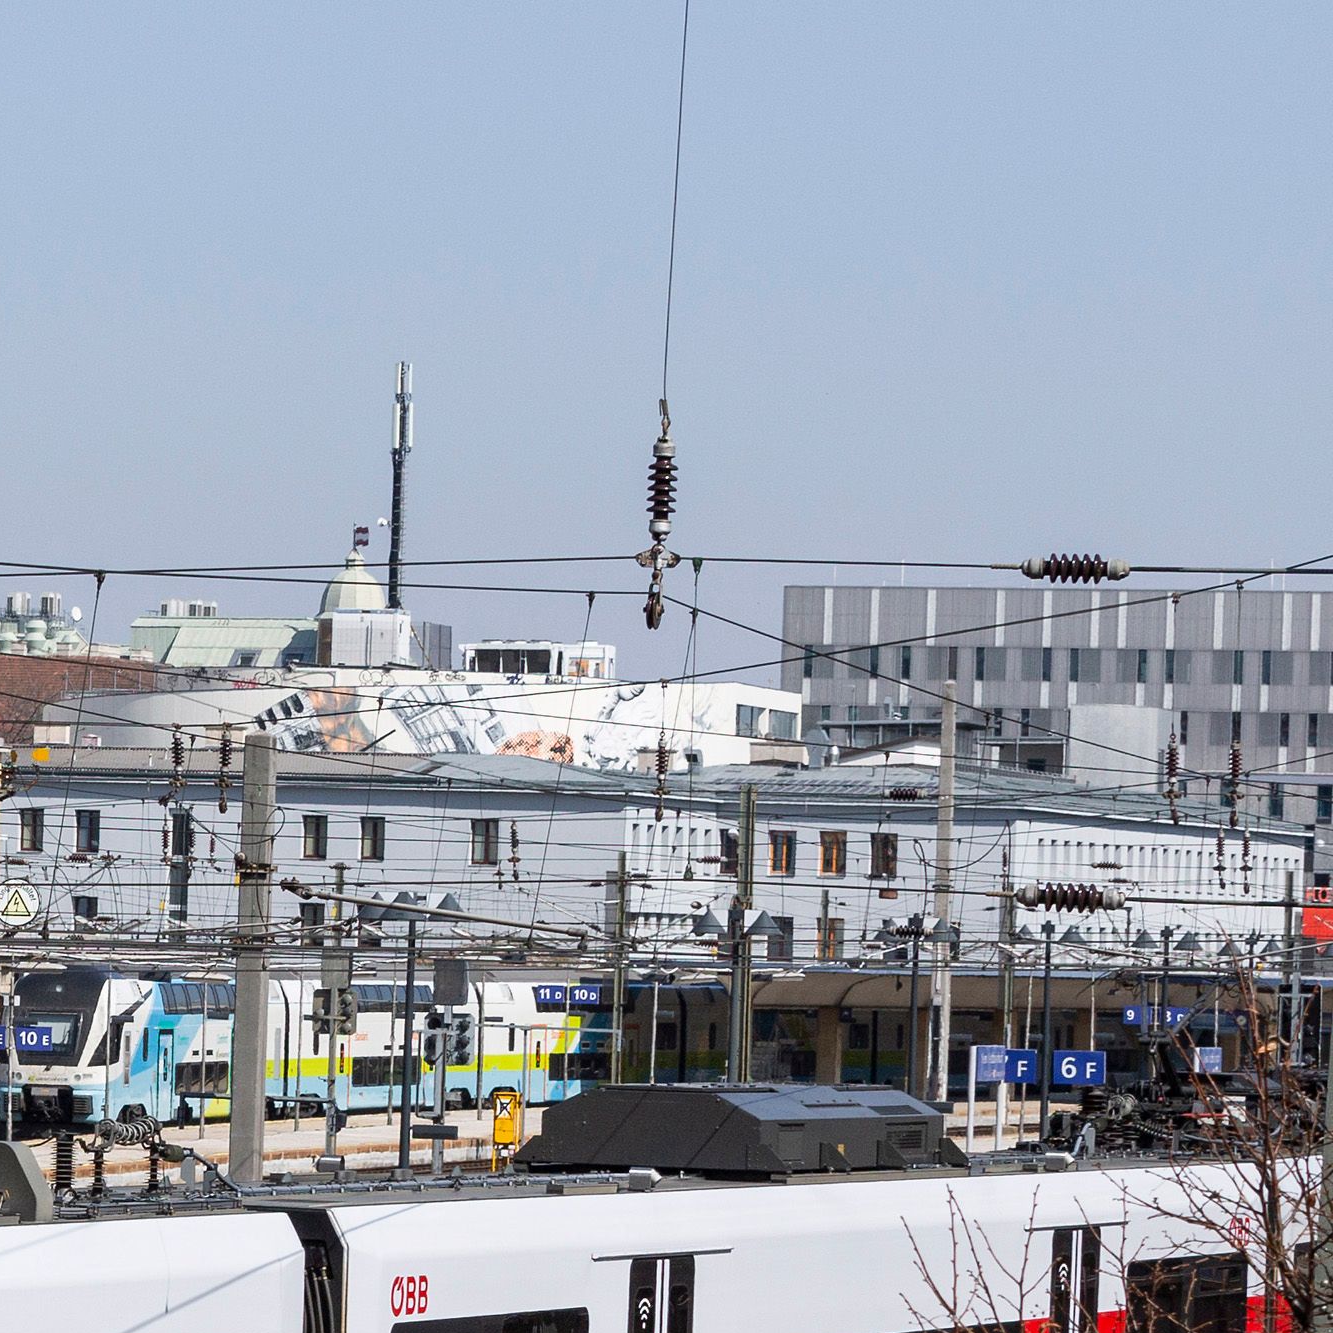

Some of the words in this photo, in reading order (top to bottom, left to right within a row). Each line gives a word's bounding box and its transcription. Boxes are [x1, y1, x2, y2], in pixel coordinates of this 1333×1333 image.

[539, 988, 551, 999] 11
[555, 991, 562, 999] D
[573, 989, 588, 1000] 10
[589, 992, 597, 1000] D
[1126, 1009, 1135, 1020] 9
[19, 1031, 37, 1045] 10
[42, 1035, 50, 1046] E
[1016, 1061, 1028, 1077] F
[1061, 1056, 1077, 1079] 6
[1085, 1062, 1097, 1079] F
[391, 1274, 429, 1317] ÖBB
